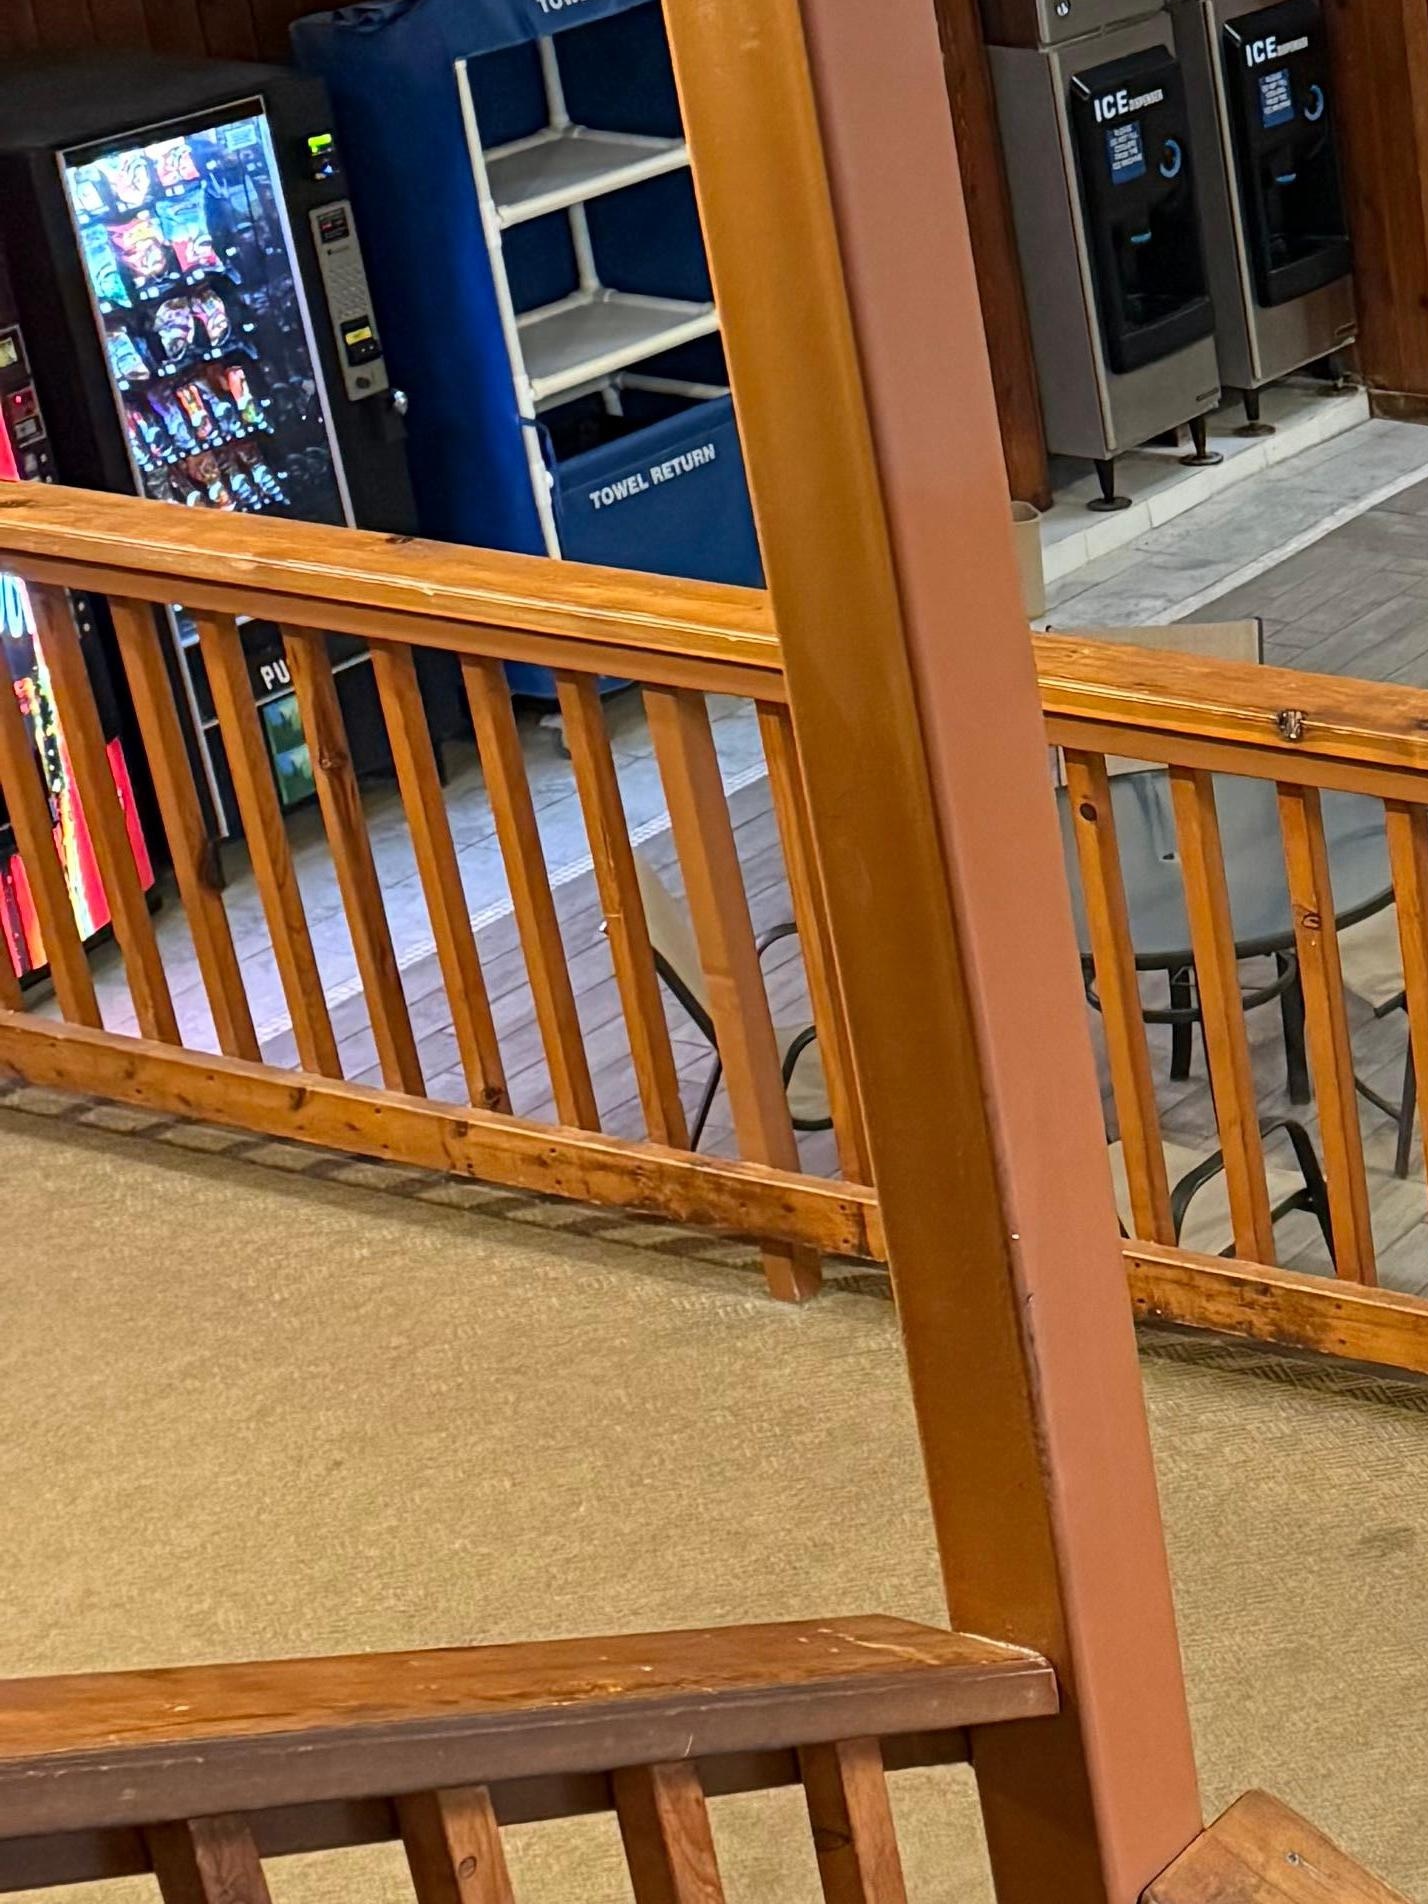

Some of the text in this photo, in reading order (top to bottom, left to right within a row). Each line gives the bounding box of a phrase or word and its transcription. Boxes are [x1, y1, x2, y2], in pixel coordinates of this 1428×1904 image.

[1245, 35, 1277, 68] ICE
[1093, 88, 1129, 124] ICE
[588, 442, 717, 510] TOWEL RETURN
[260, 658, 291, 691] PU
